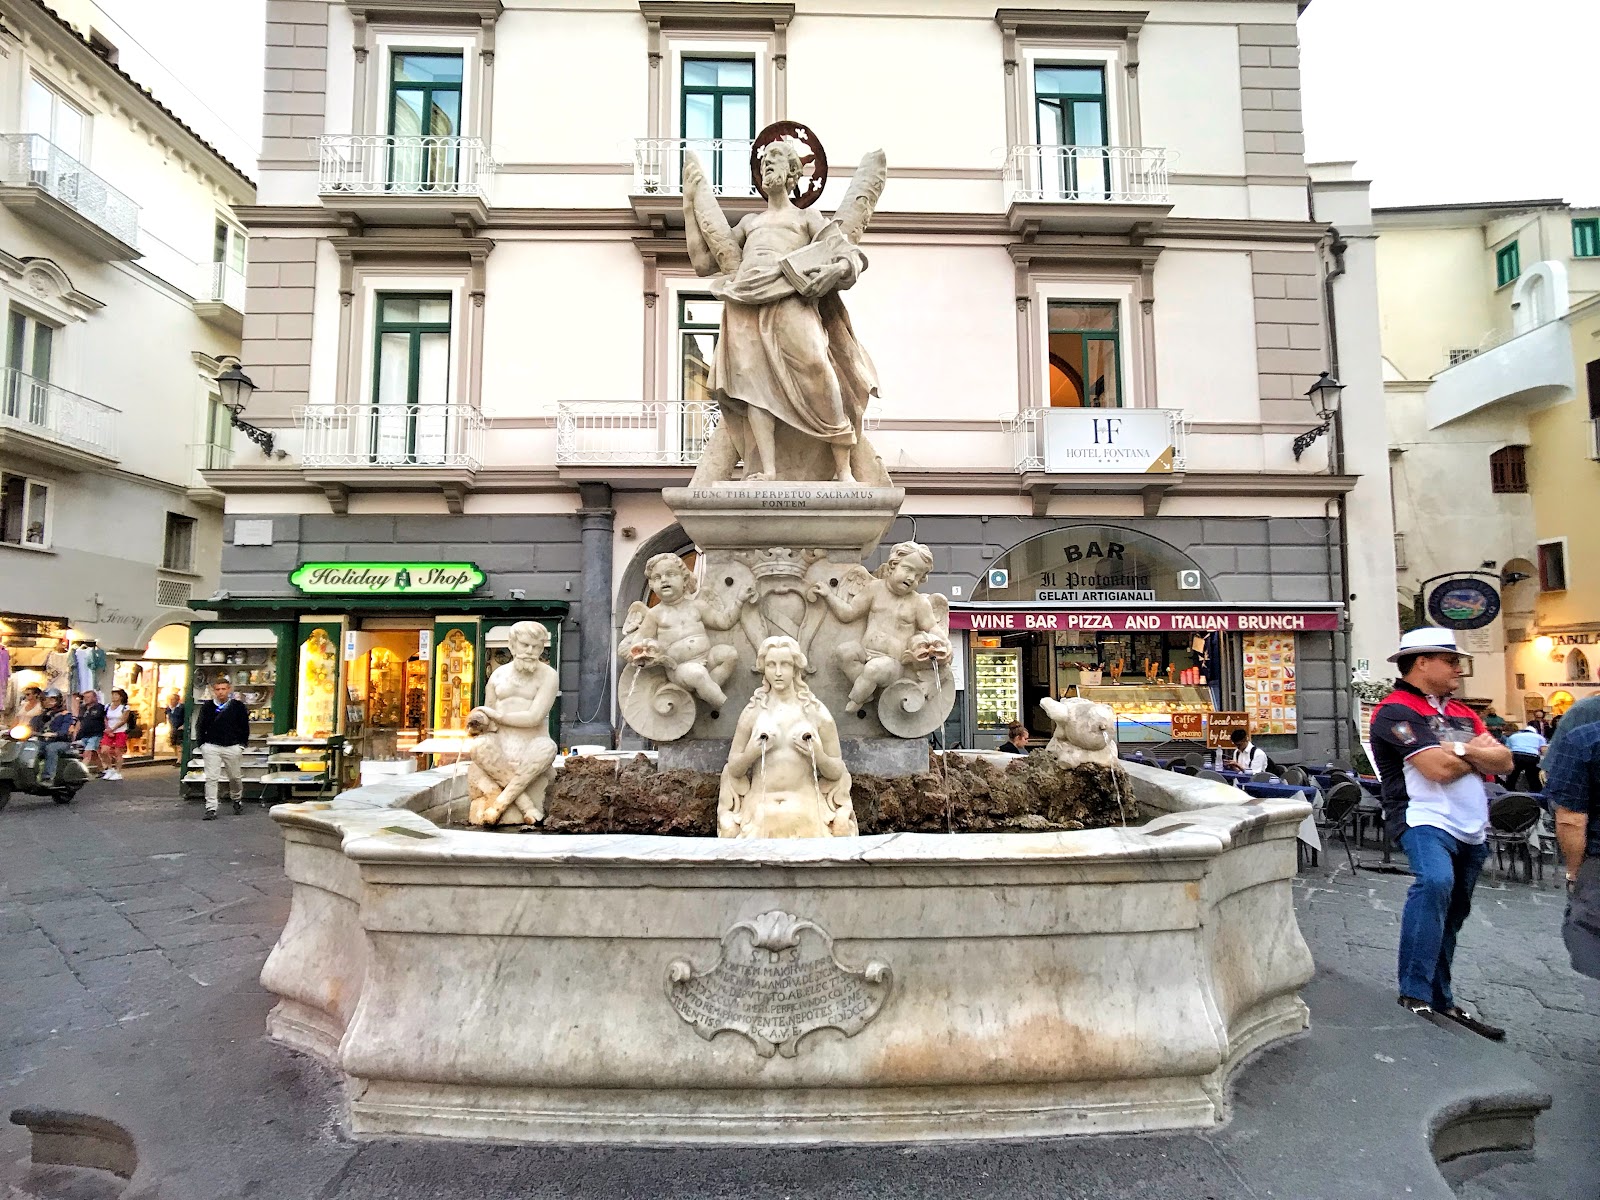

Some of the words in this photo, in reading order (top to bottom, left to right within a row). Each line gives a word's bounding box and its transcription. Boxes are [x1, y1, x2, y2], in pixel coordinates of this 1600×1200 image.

[1066, 448, 1101, 458] HOTEL
[1104, 448, 1150, 458] FONTANA
[692, 490, 721, 499] HUNC
[726, 490, 751, 499] TIBI
[754, 490, 812, 499] PERPETUO
[815, 490, 874, 499] SACRAMUS
[761, 500, 806, 508] FONTEM
[1063, 541, 1125, 563] BAR
[308, 567, 391, 590] Holiday
[418, 567, 471, 590] Shop
[1039, 591, 1078, 601] GELATI
[1082, 591, 1153, 601] ARTIGIANALI
[970, 614, 1015, 629] WINE
[1025, 614, 1058, 629] BAR
[1068, 614, 1113, 629] PIZZA
[1125, 614, 1161, 629] AND
[1171, 615, 1229, 629] ITALIAN
[1238, 615, 1305, 630] BRUNCH
[1209, 714, 1231, 726] Local
[1172, 728, 1202, 738] Cappuccino
[1209, 729, 1219, 744] by
